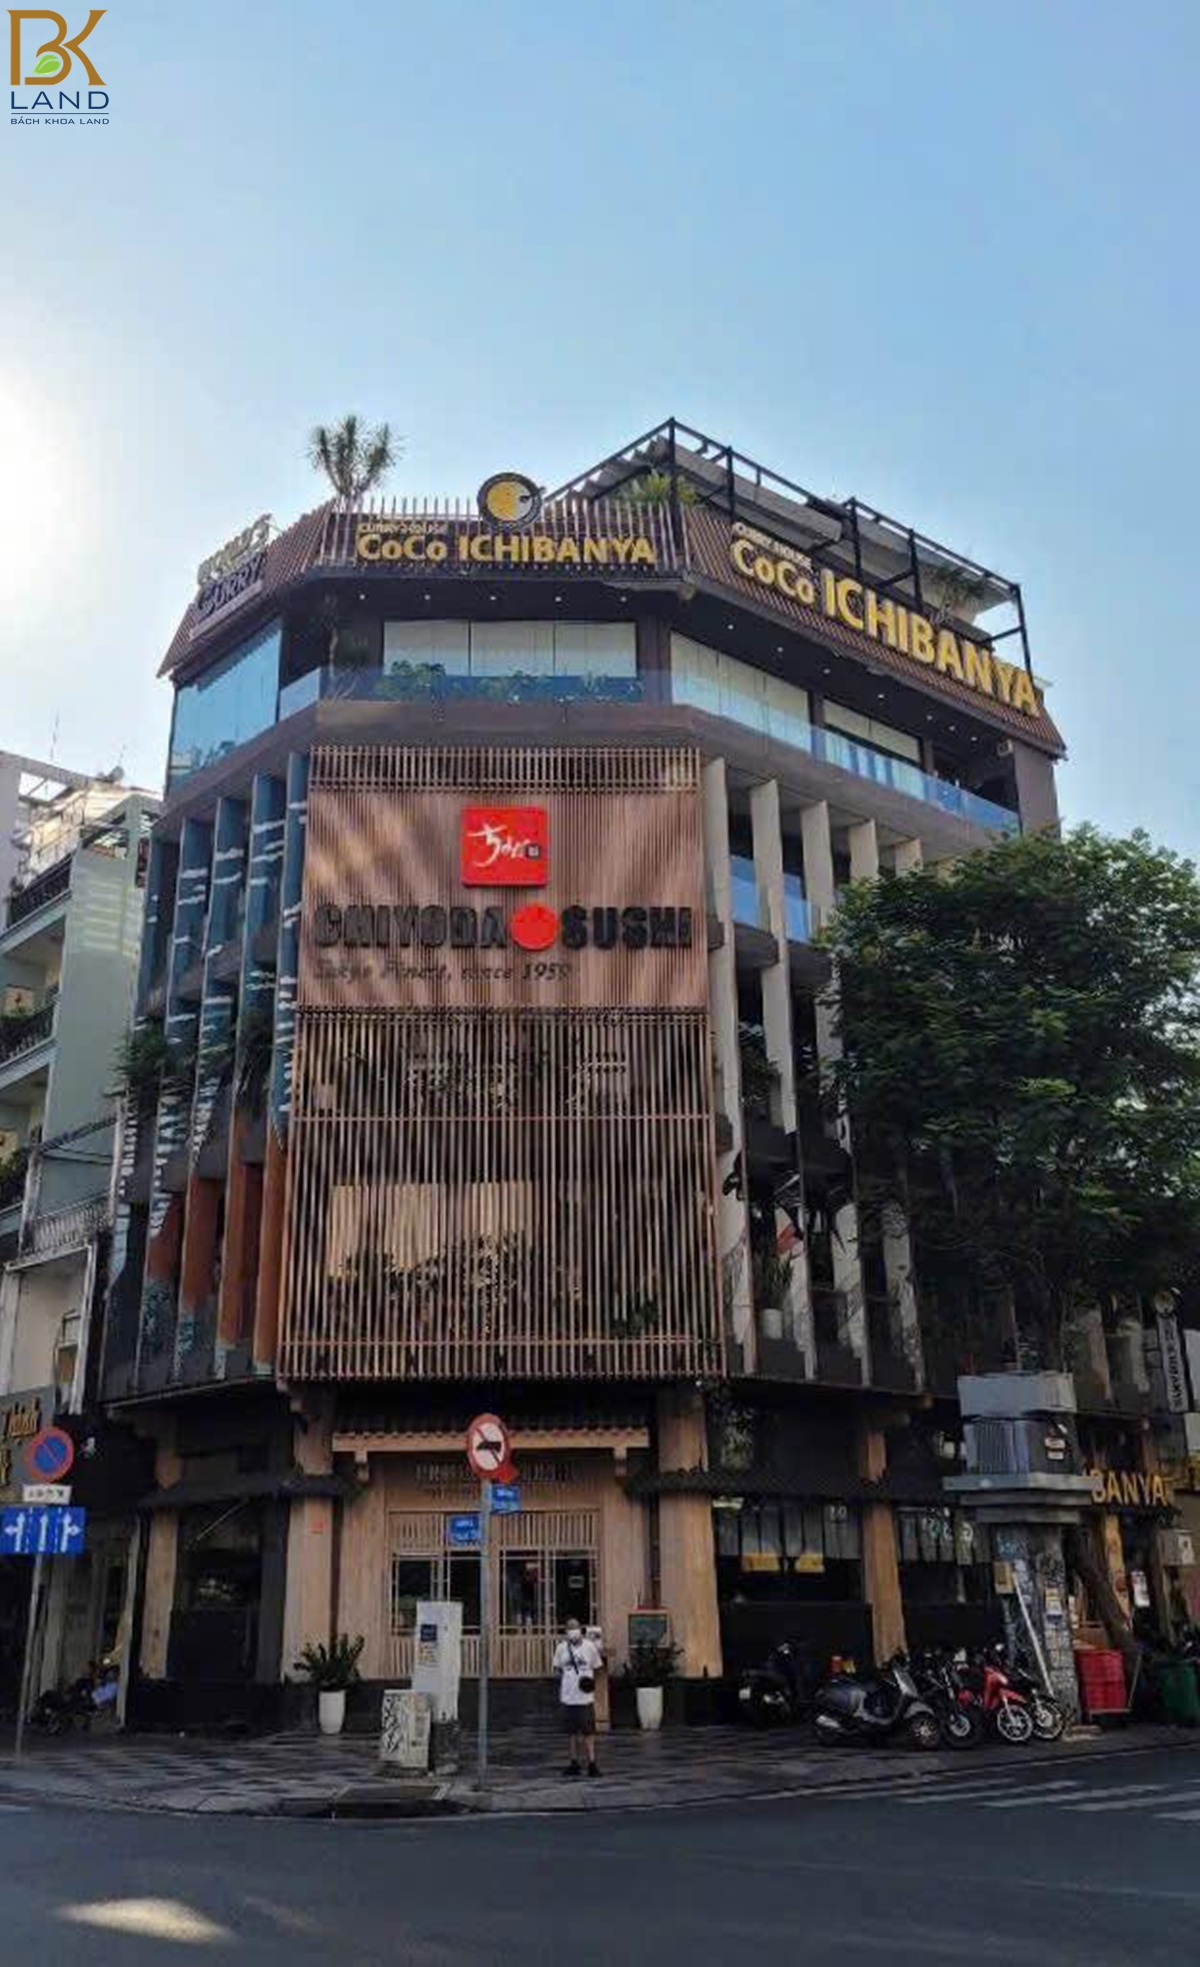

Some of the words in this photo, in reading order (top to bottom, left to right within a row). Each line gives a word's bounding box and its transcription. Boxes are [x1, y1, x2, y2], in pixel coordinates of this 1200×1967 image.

[357, 533, 448, 561] CoCo
[459, 535, 656, 565] ICHIBANYA
[731, 538, 815, 604] CoCo
[820, 567, 1040, 718] ICHIBANYA
[313, 902, 508, 950] CHIYODA
[560, 903, 693, 950] SUSHI
[1083, 1468, 1168, 1506] BANYA
